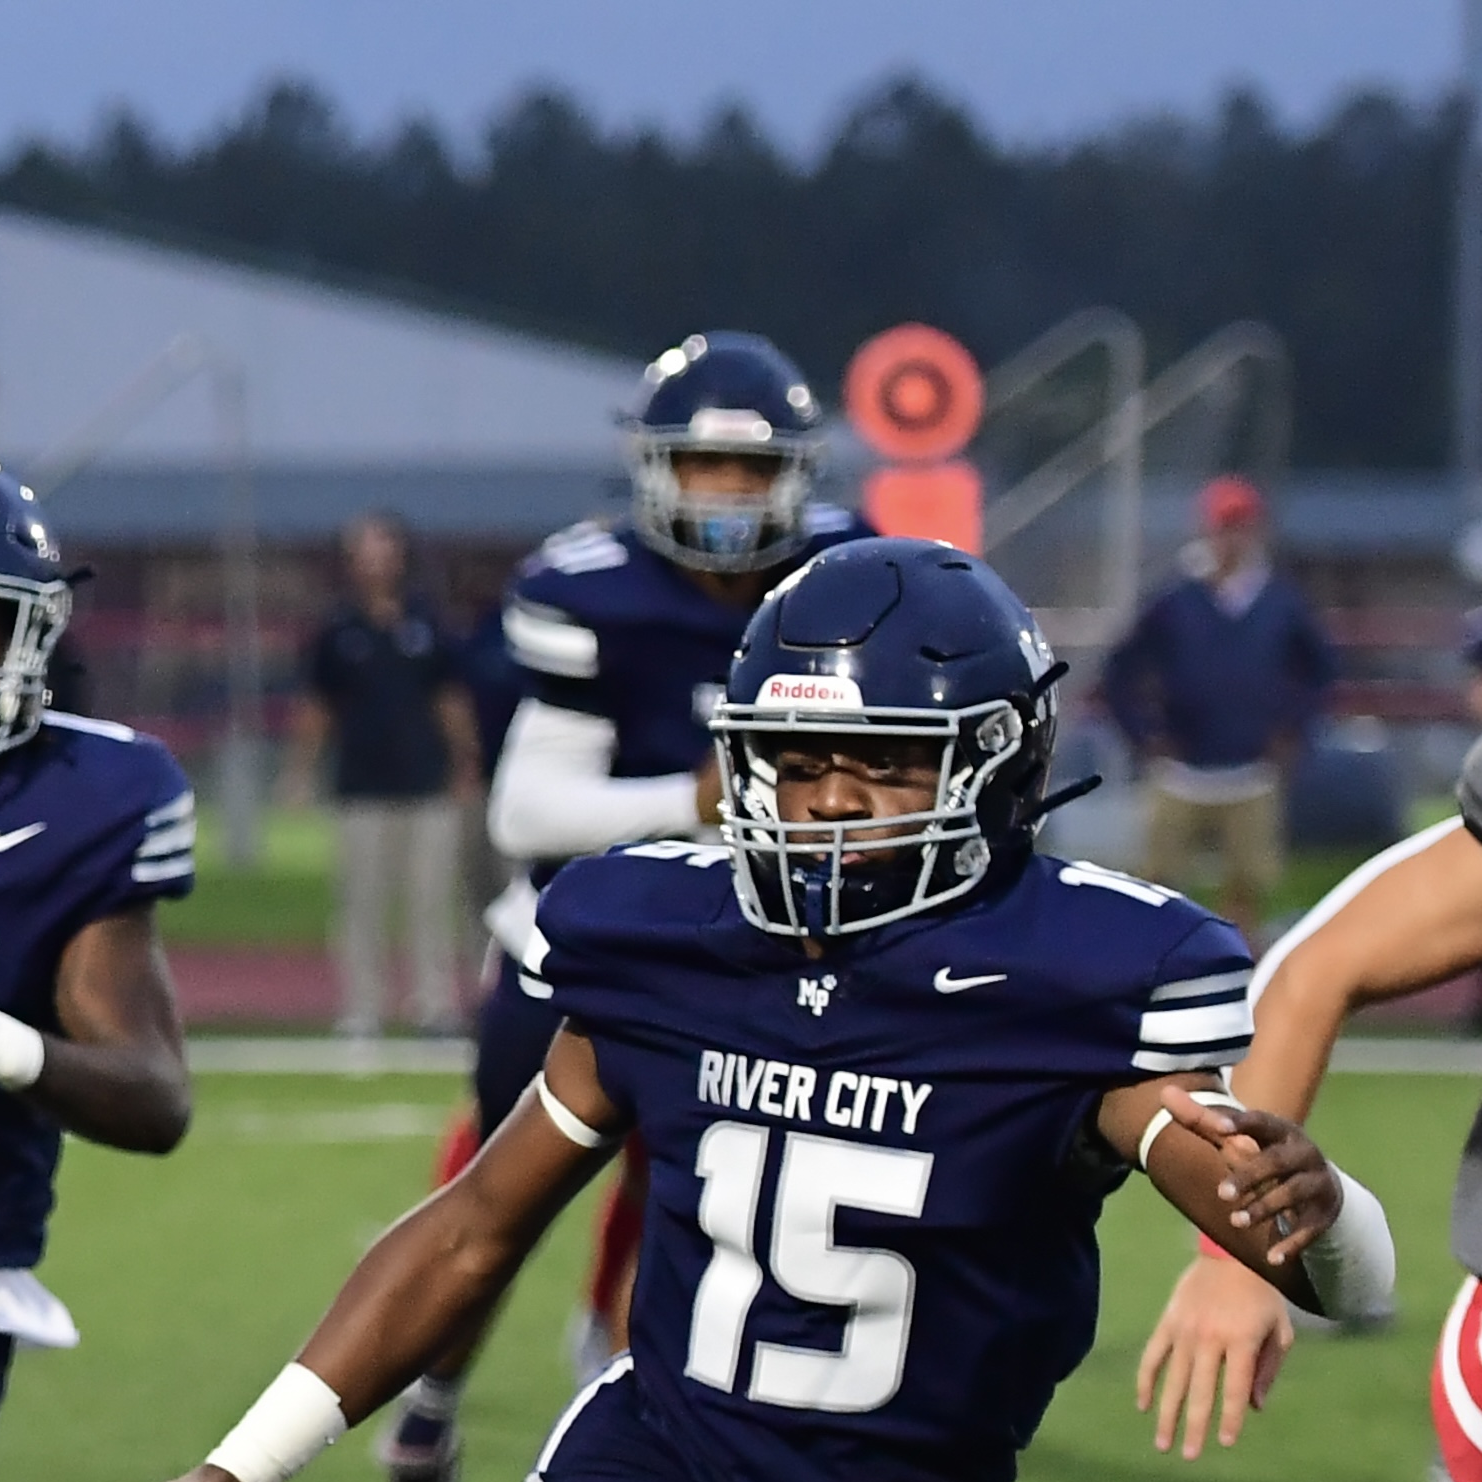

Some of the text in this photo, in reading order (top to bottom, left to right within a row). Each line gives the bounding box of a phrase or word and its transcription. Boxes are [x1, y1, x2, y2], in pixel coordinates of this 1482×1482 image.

[1058, 860, 1185, 908] 1
[697, 1049, 933, 1136] RIVER CITY
[683, 1119, 935, 1414] 15
